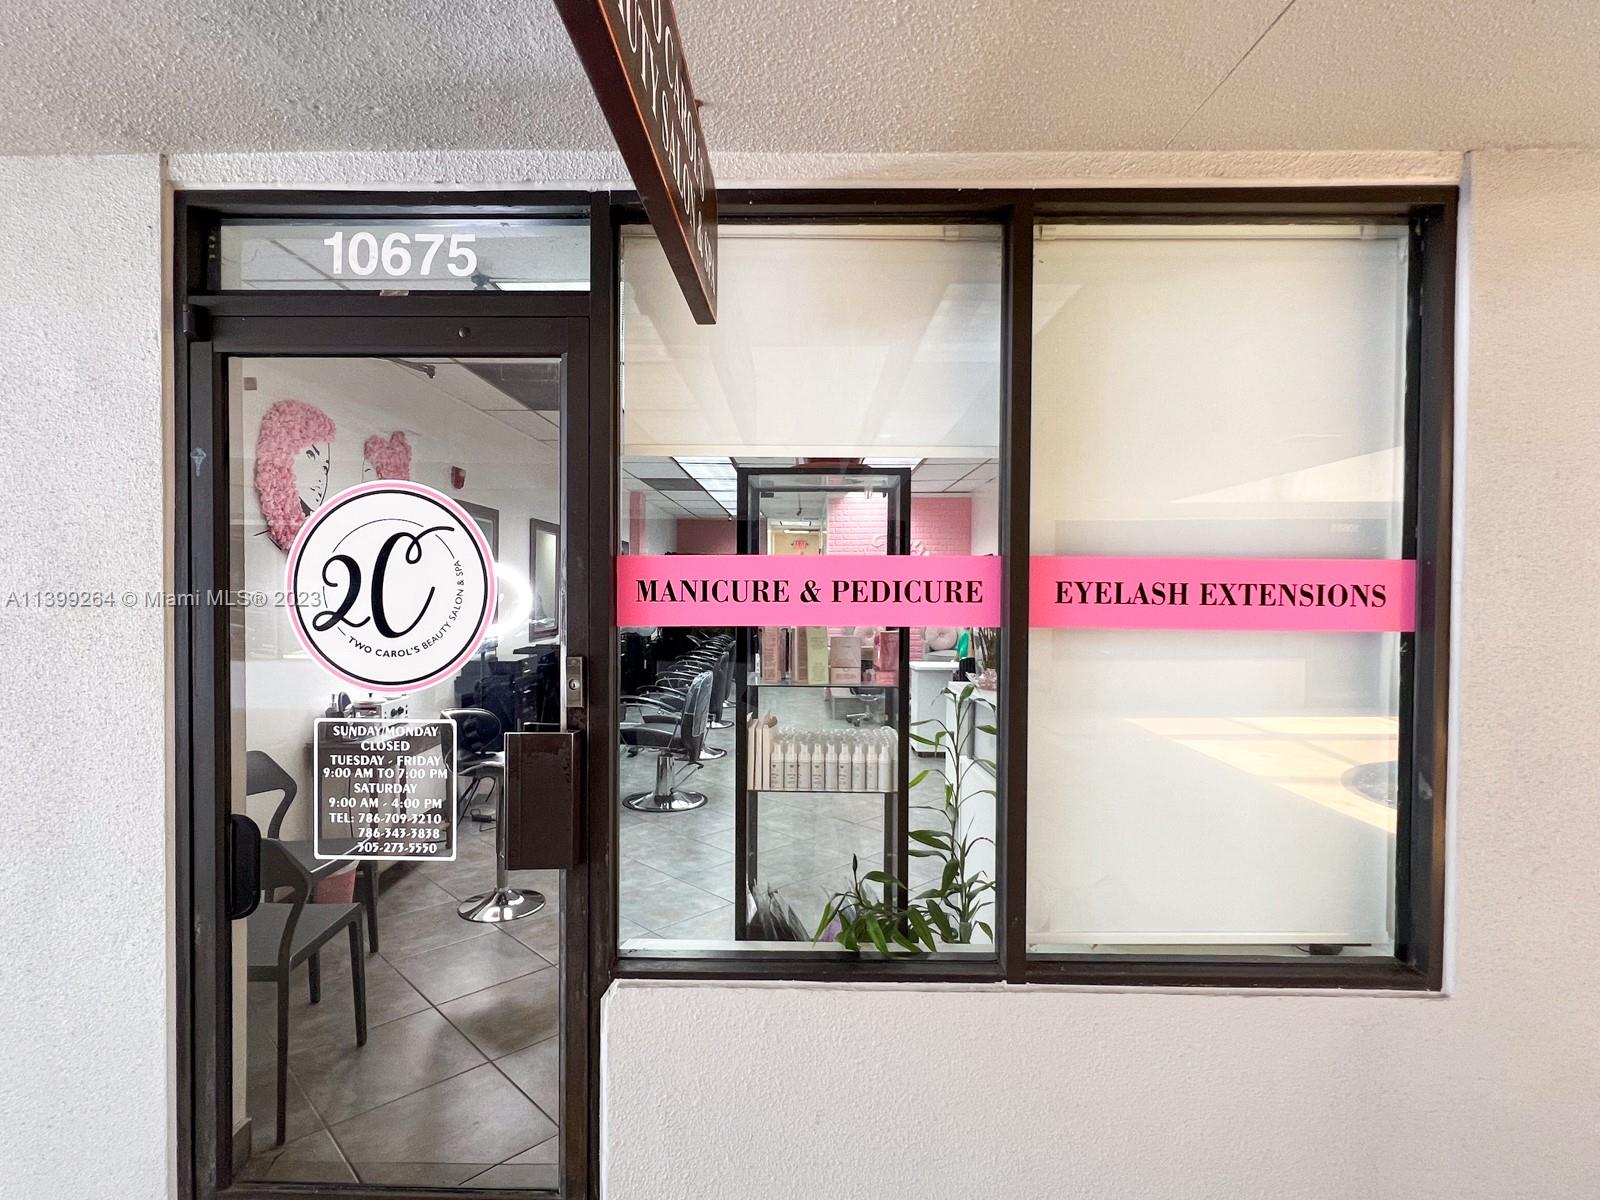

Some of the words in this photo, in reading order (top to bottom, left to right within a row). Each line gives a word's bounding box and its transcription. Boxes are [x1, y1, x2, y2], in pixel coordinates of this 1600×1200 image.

[617, 0, 660, 121] UTY
[661, 90, 696, 237] SALON
[697, 211, 704, 258] &
[323, 231, 478, 277] 10675
[453, 559, 464, 577] SPA
[635, 578, 790, 604] MANICURE
[800, 579, 822, 604] &
[831, 579, 984, 604] PEDICURE
[1054, 580, 1190, 606] EYELASH
[1199, 582, 1387, 609] EXTENSIONS
[448, 588, 465, 621] SALON
[421, 621, 452, 650] BEAUTY
[348, 635, 373, 654] TWO
[375, 645, 421, 658] CAROL'S
[333, 725, 440, 738] SUNDAY/MONDAY
[360, 740, 411, 752] CLOSED
[329, 754, 385, 766] TUESDAY
[396, 755, 442, 767] FRIDAY
[322, 767, 351, 778] 9:00
[354, 767, 374, 779] AM
[377, 768, 395, 779] TO
[398, 767, 426, 779] 7:00
[429, 768, 448, 780] PM
[353, 782, 418, 795] SATURDAY
[328, 797, 357, 808] 9:00
[359, 797, 379, 808] AM
[391, 798, 420, 809] 4:00
[424, 798, 443, 809] PM
[328, 812, 355, 823] TEL:
[358, 812, 442, 824] 786-709-3210
[357, 827, 441, 839] 786-343-3838
[357, 841, 438, 854] 305-273-5550
